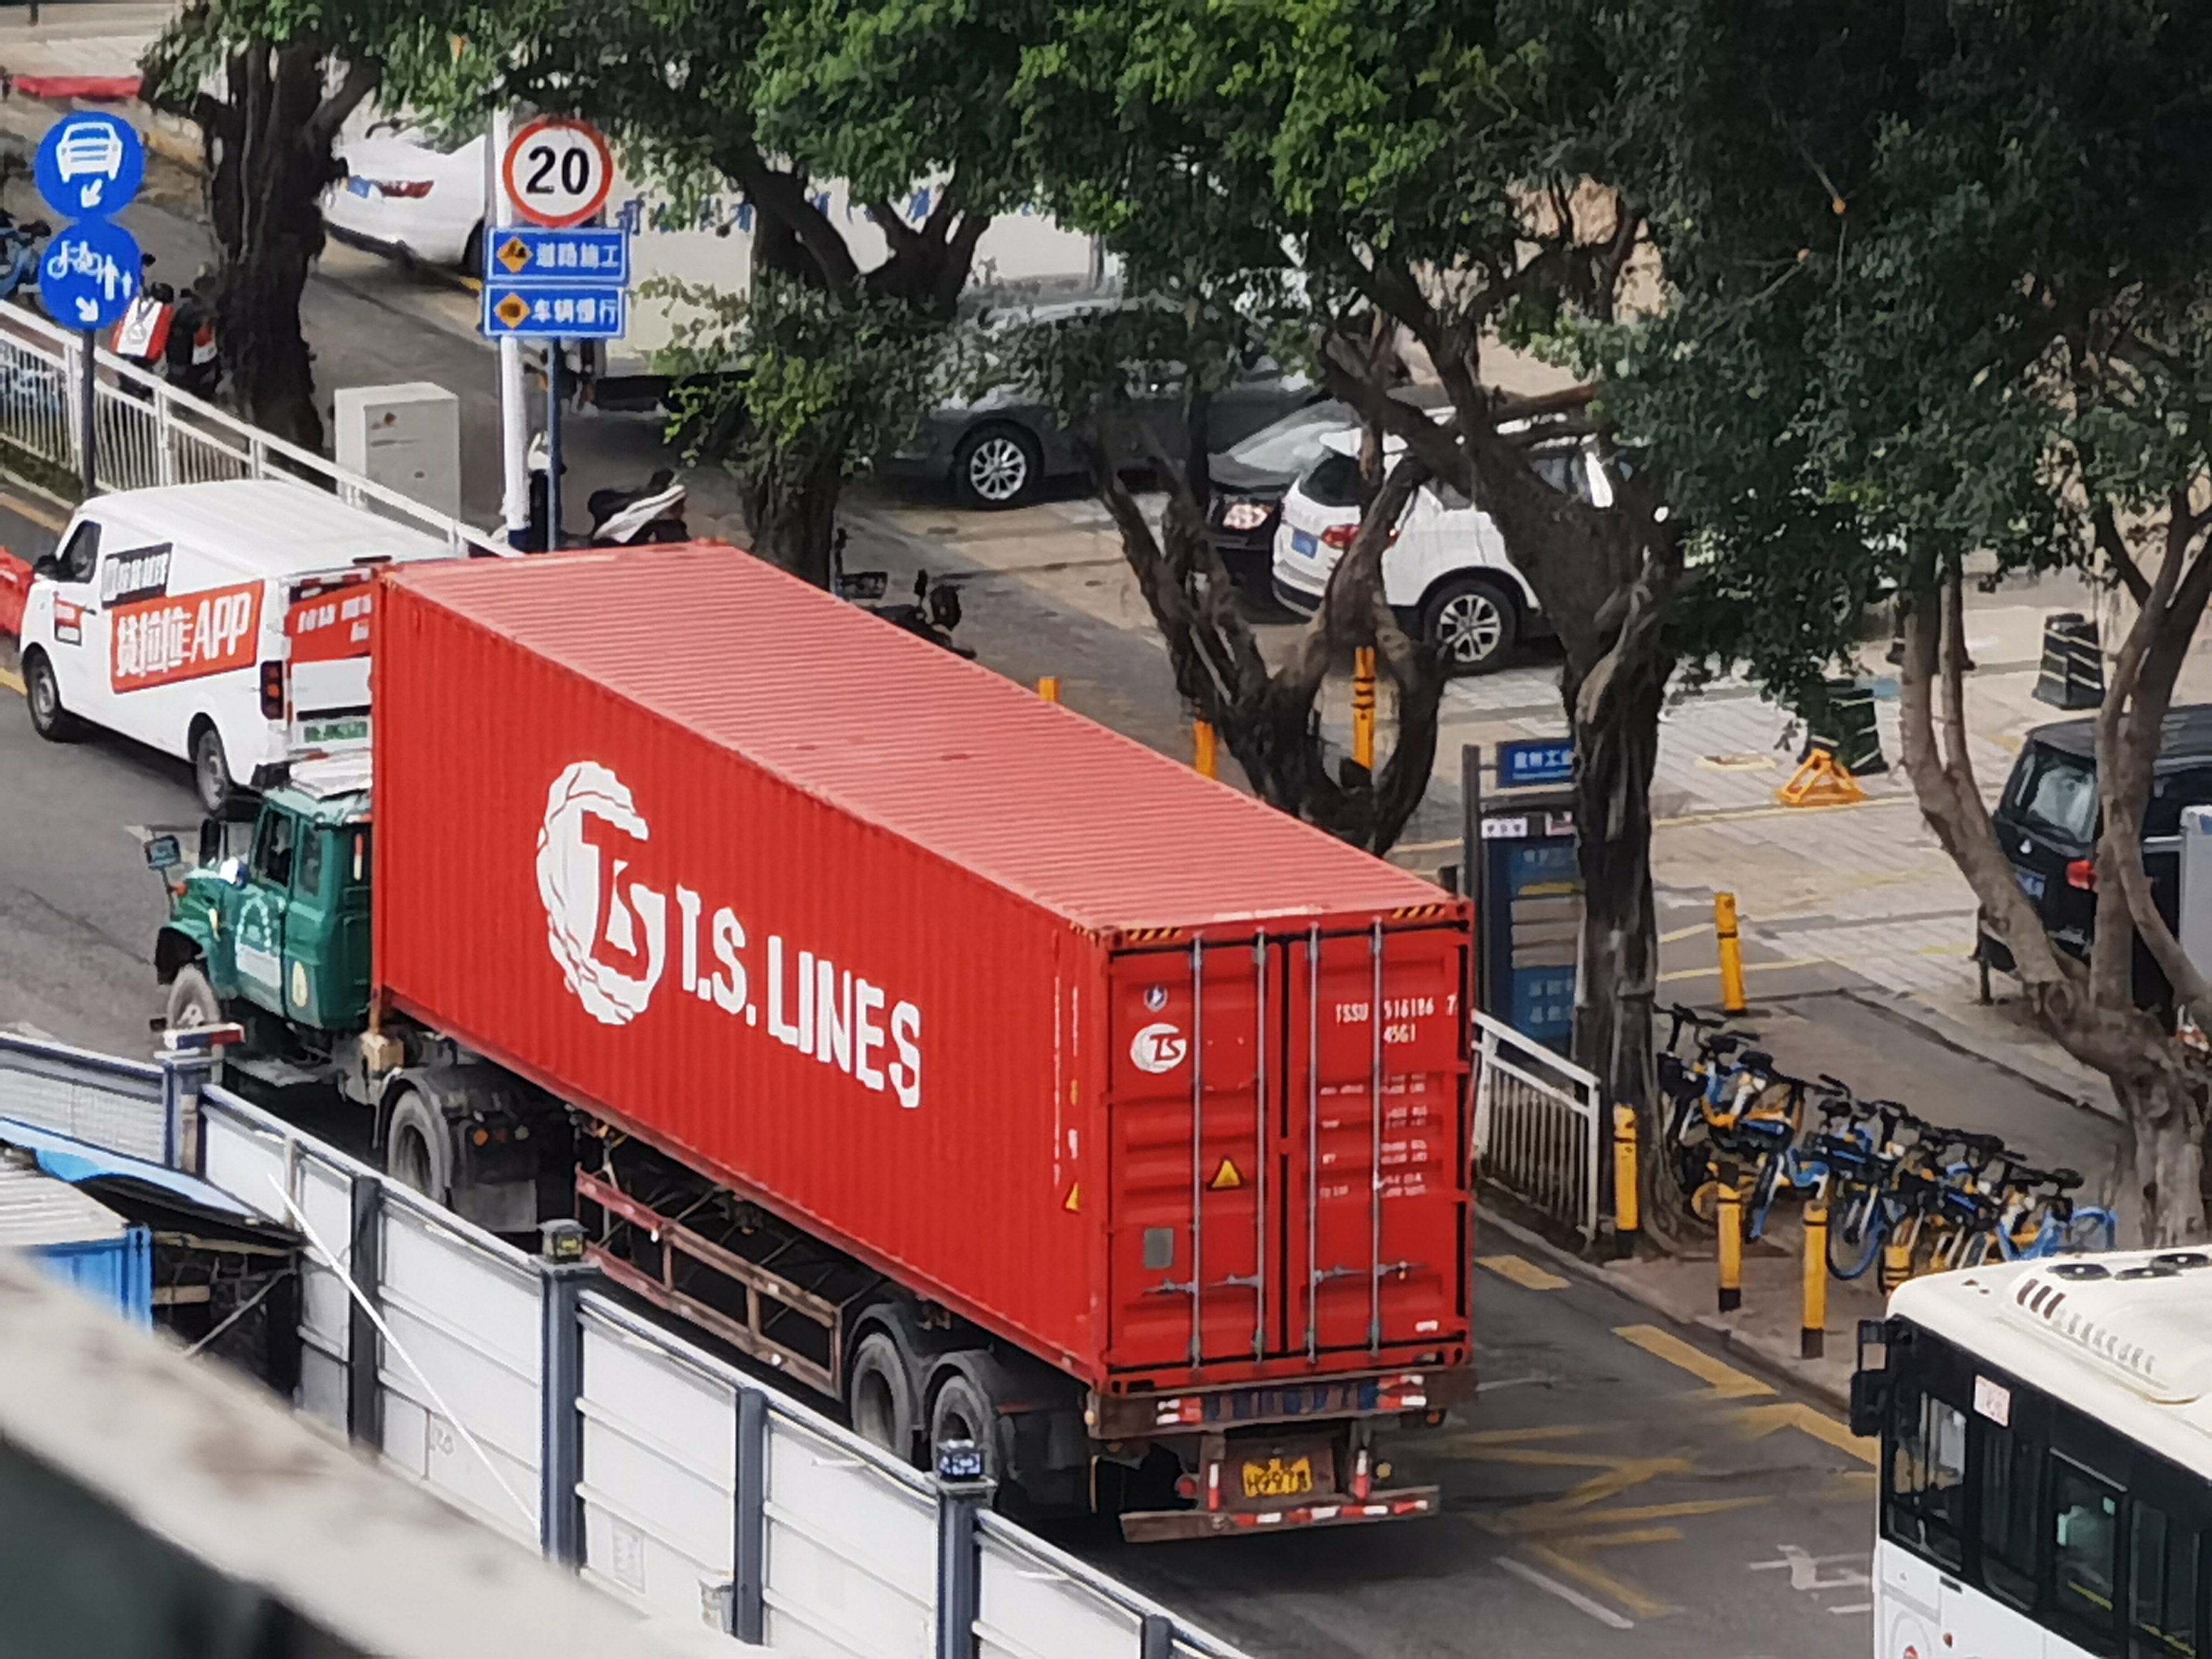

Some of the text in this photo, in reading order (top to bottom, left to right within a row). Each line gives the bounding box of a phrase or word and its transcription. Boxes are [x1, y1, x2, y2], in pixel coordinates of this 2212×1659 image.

[526, 145, 590, 195] 20
[676, 883, 756, 1027] T.S.
[767, 935, 920, 1108] LINES
